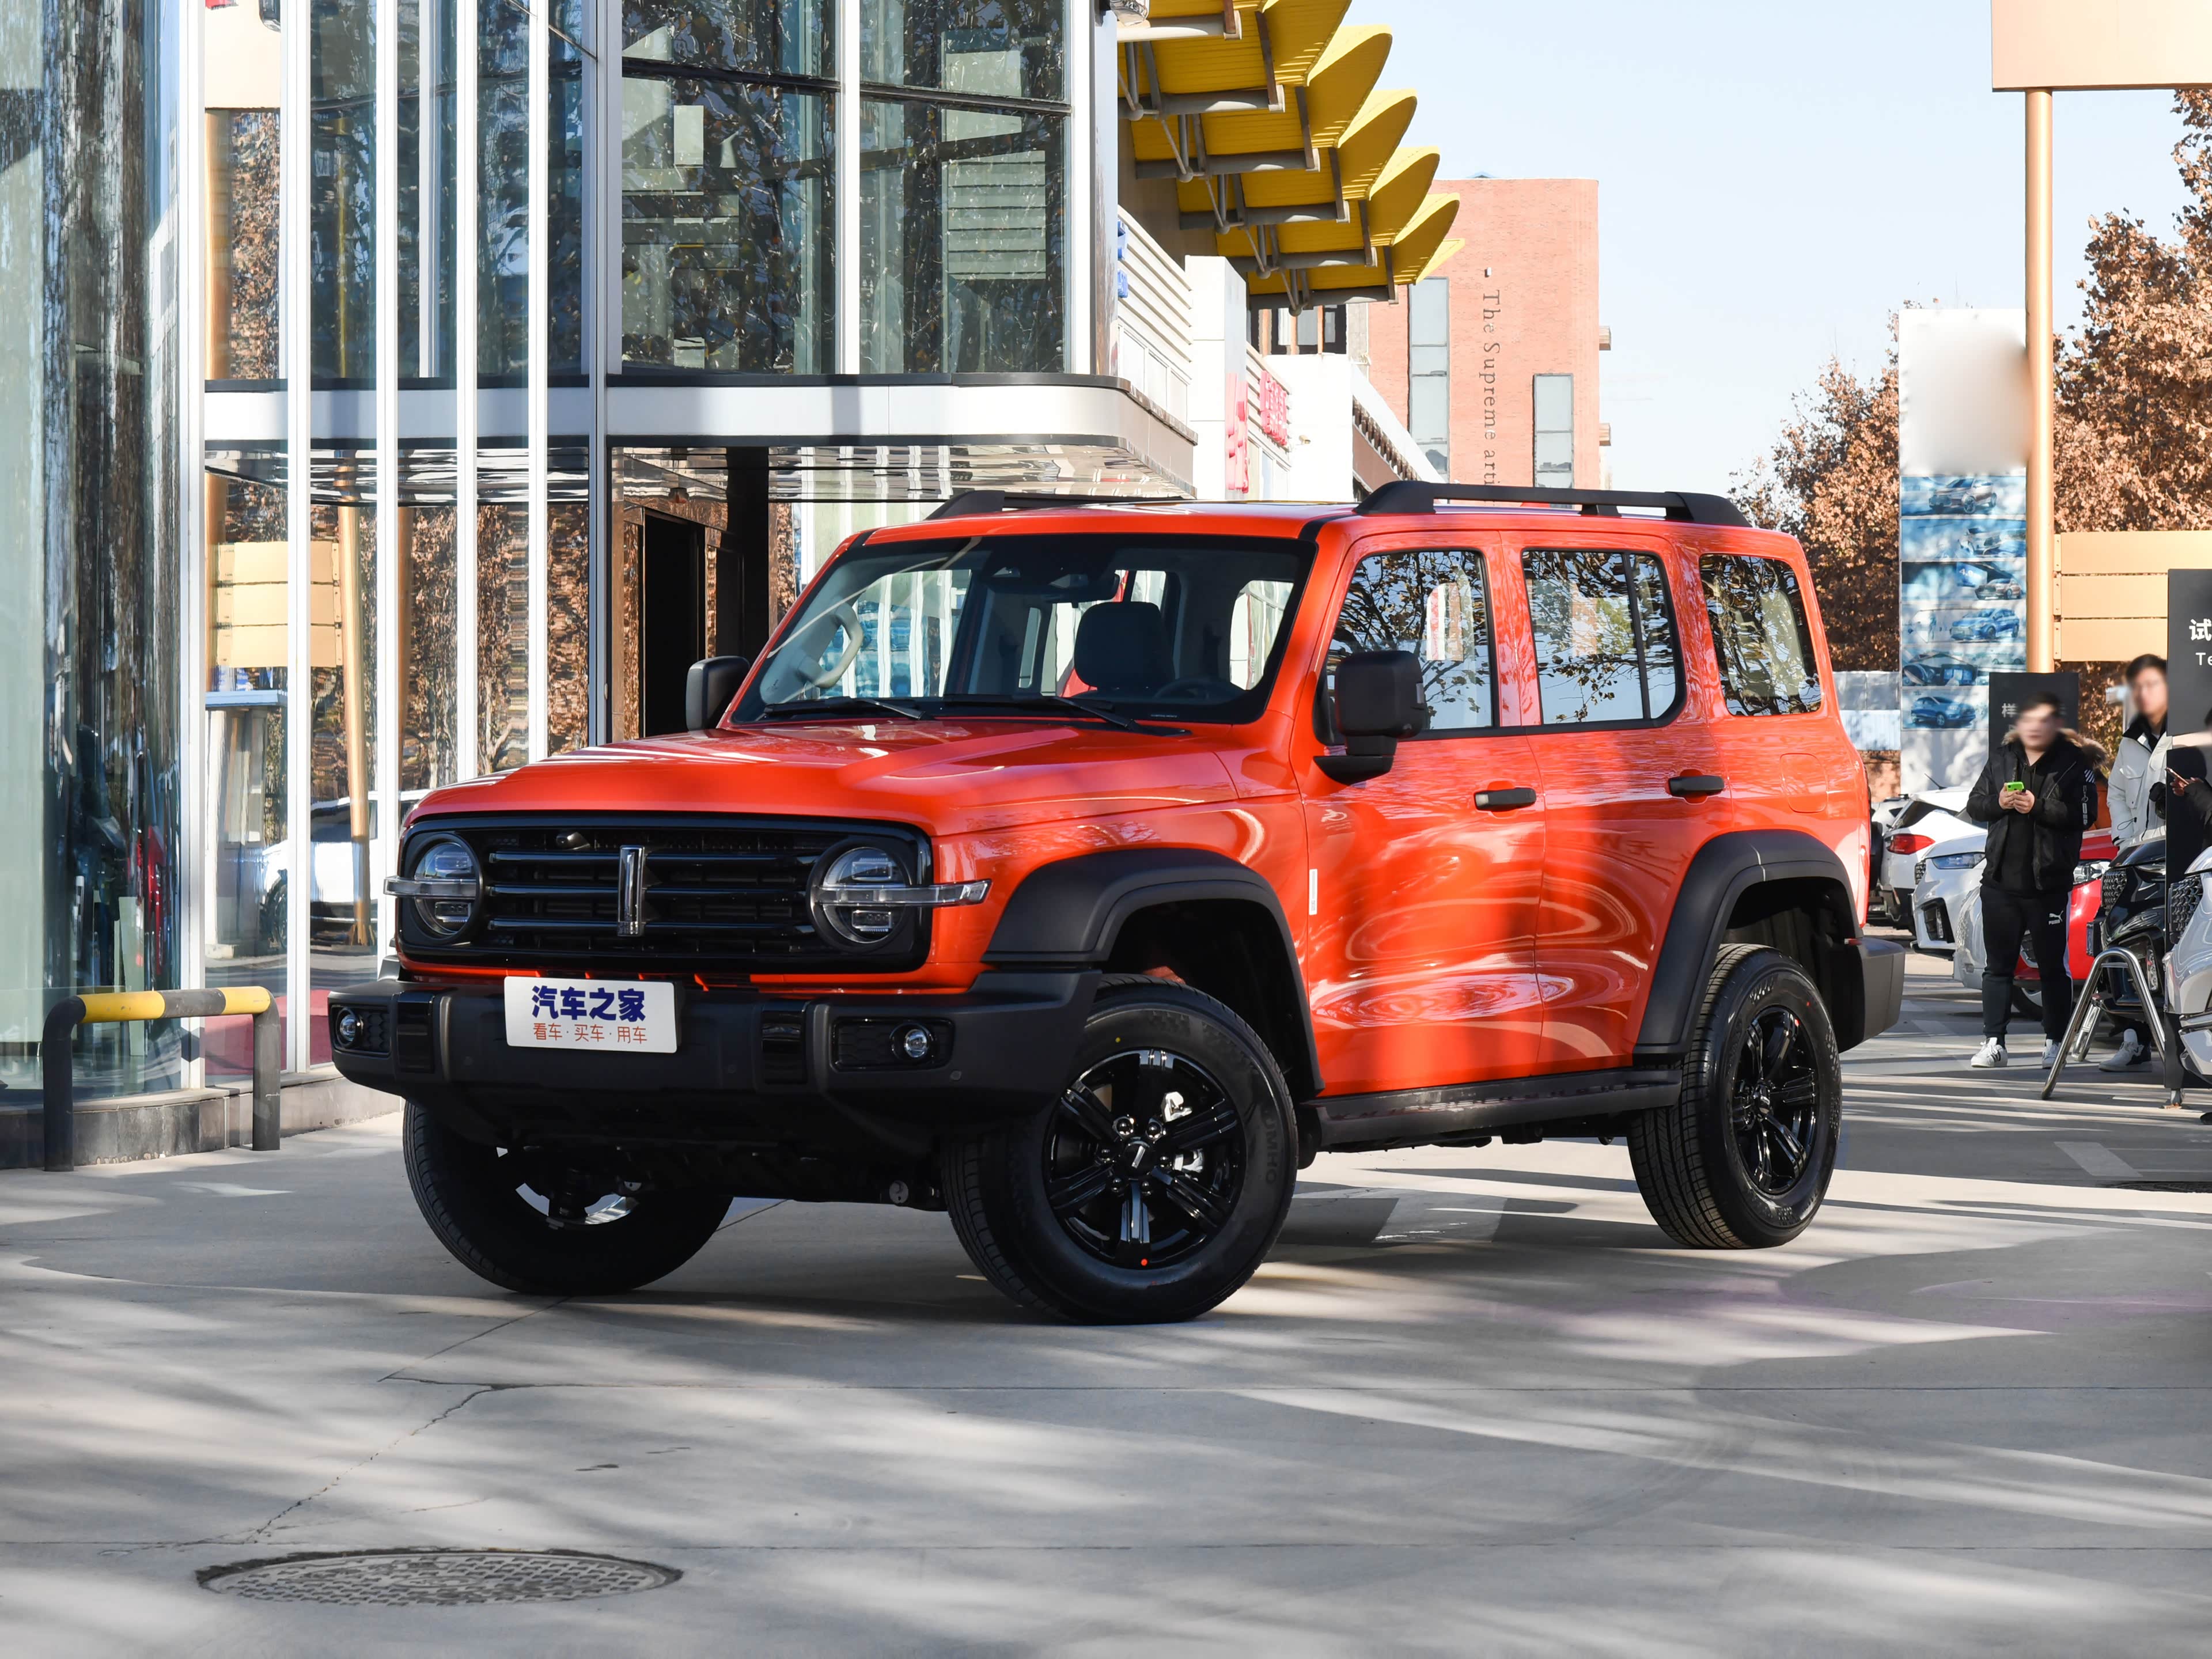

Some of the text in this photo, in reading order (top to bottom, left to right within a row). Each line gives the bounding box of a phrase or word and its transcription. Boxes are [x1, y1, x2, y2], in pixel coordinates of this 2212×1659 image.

[1479, 289, 1501, 486] The Supreme arti
[2188, 618, 2212, 641] 试
[532, 985, 646, 1022] 汽车之家
[1263, 1109, 1278, 1184] UMHO
